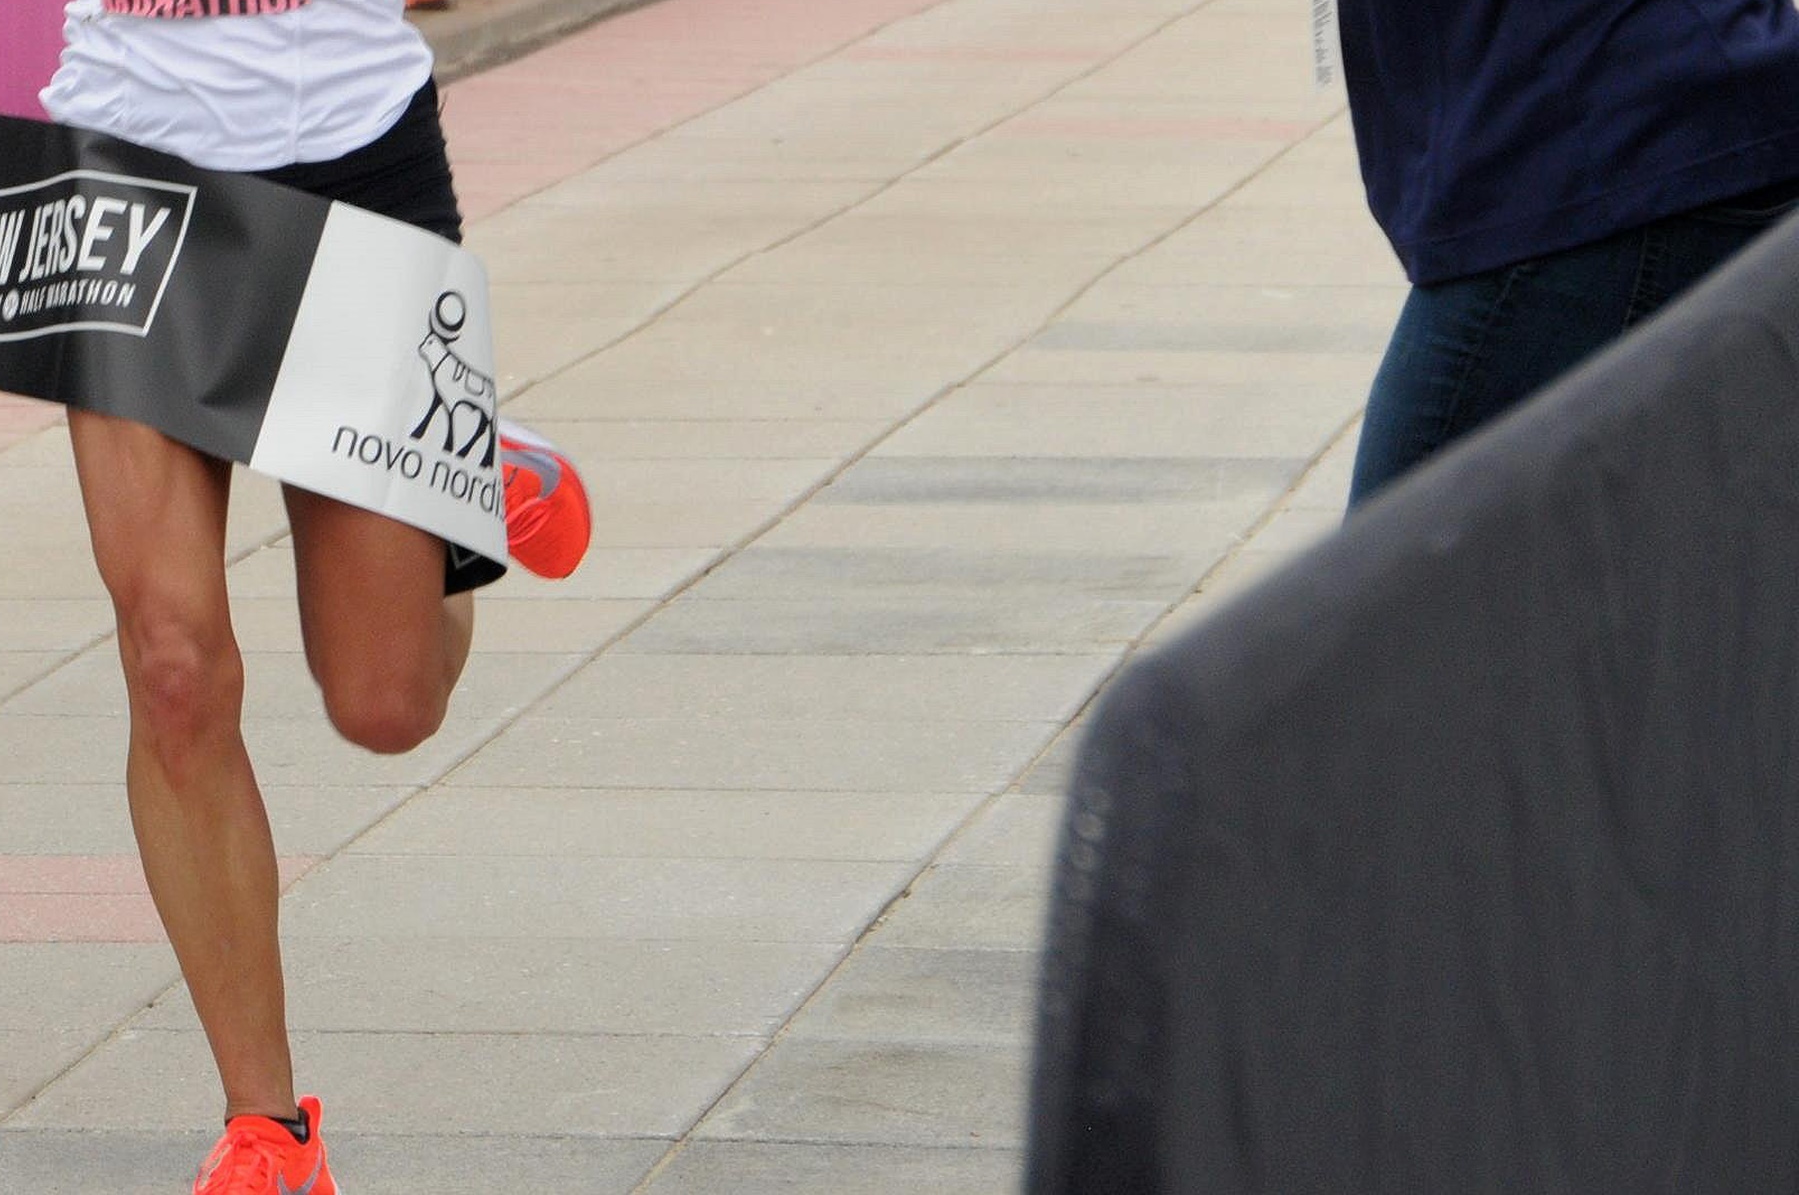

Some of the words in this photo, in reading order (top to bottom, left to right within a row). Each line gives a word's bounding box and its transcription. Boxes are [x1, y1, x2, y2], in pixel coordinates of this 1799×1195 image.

[18, 193, 172, 284] JERSEY
[18, 284, 49, 315] HALF
[46, 277, 137, 309] MARATHON
[331, 425, 423, 481] novo
[430, 460, 507, 522] nordi
